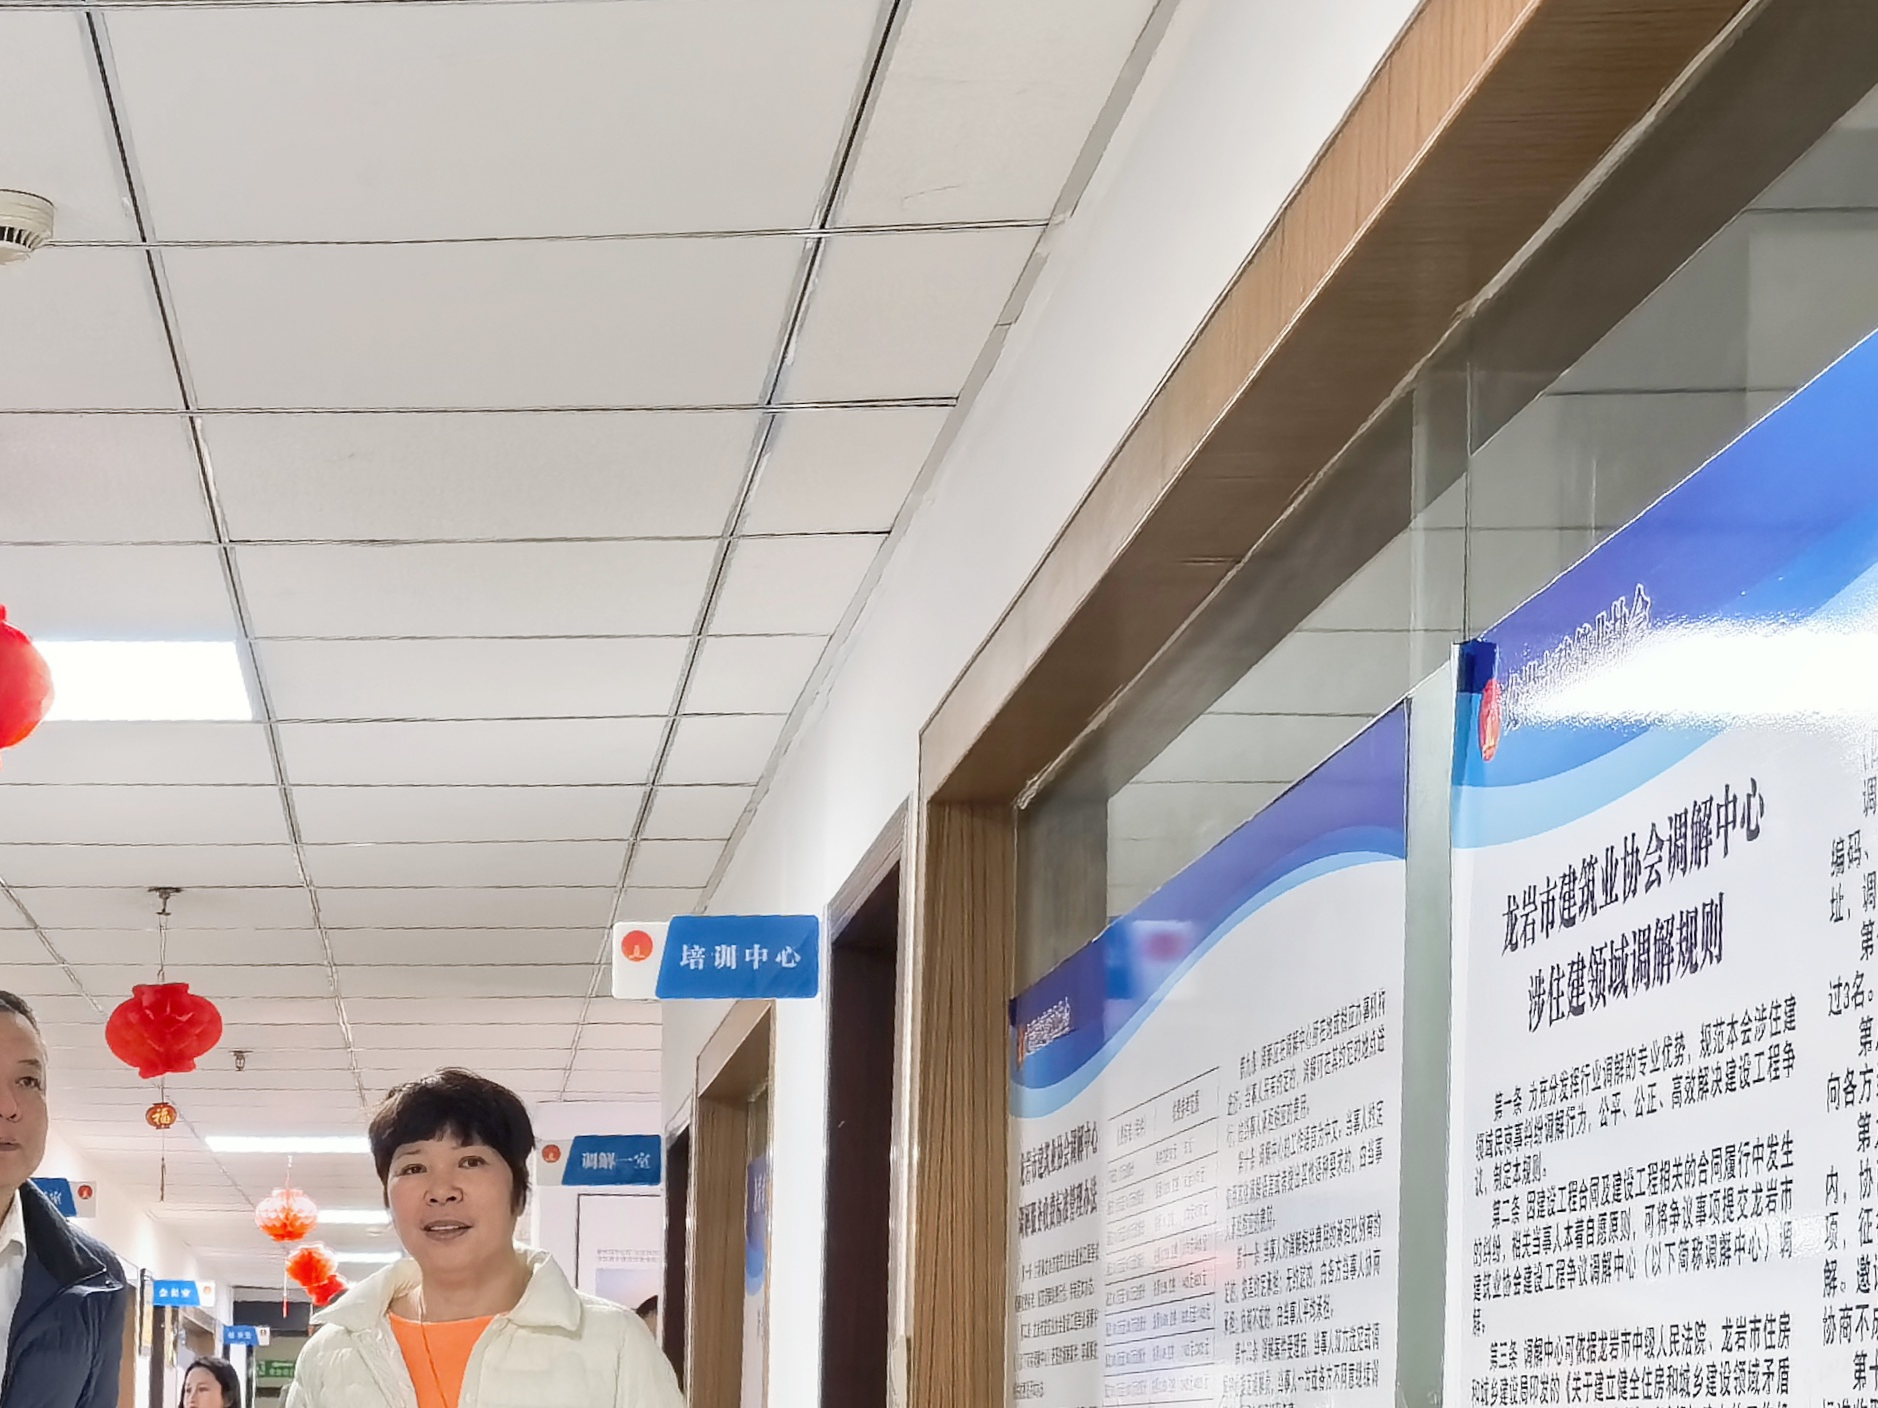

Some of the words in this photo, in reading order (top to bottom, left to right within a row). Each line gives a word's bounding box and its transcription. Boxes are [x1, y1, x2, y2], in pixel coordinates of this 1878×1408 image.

[1501, 778, 1763, 956] 龙岩市建筑业协会调解中心
[680, 944, 802, 970] 培训中心
[1527, 892, 1724, 1032] 涉住建领域调解规则
[1826, 1063, 1878, 1112] 向各方
[151, 1107, 172, 1126] 福
[1825, 1157, 1878, 1206] 内，协
[1825, 1207, 1878, 1251] 项，征
